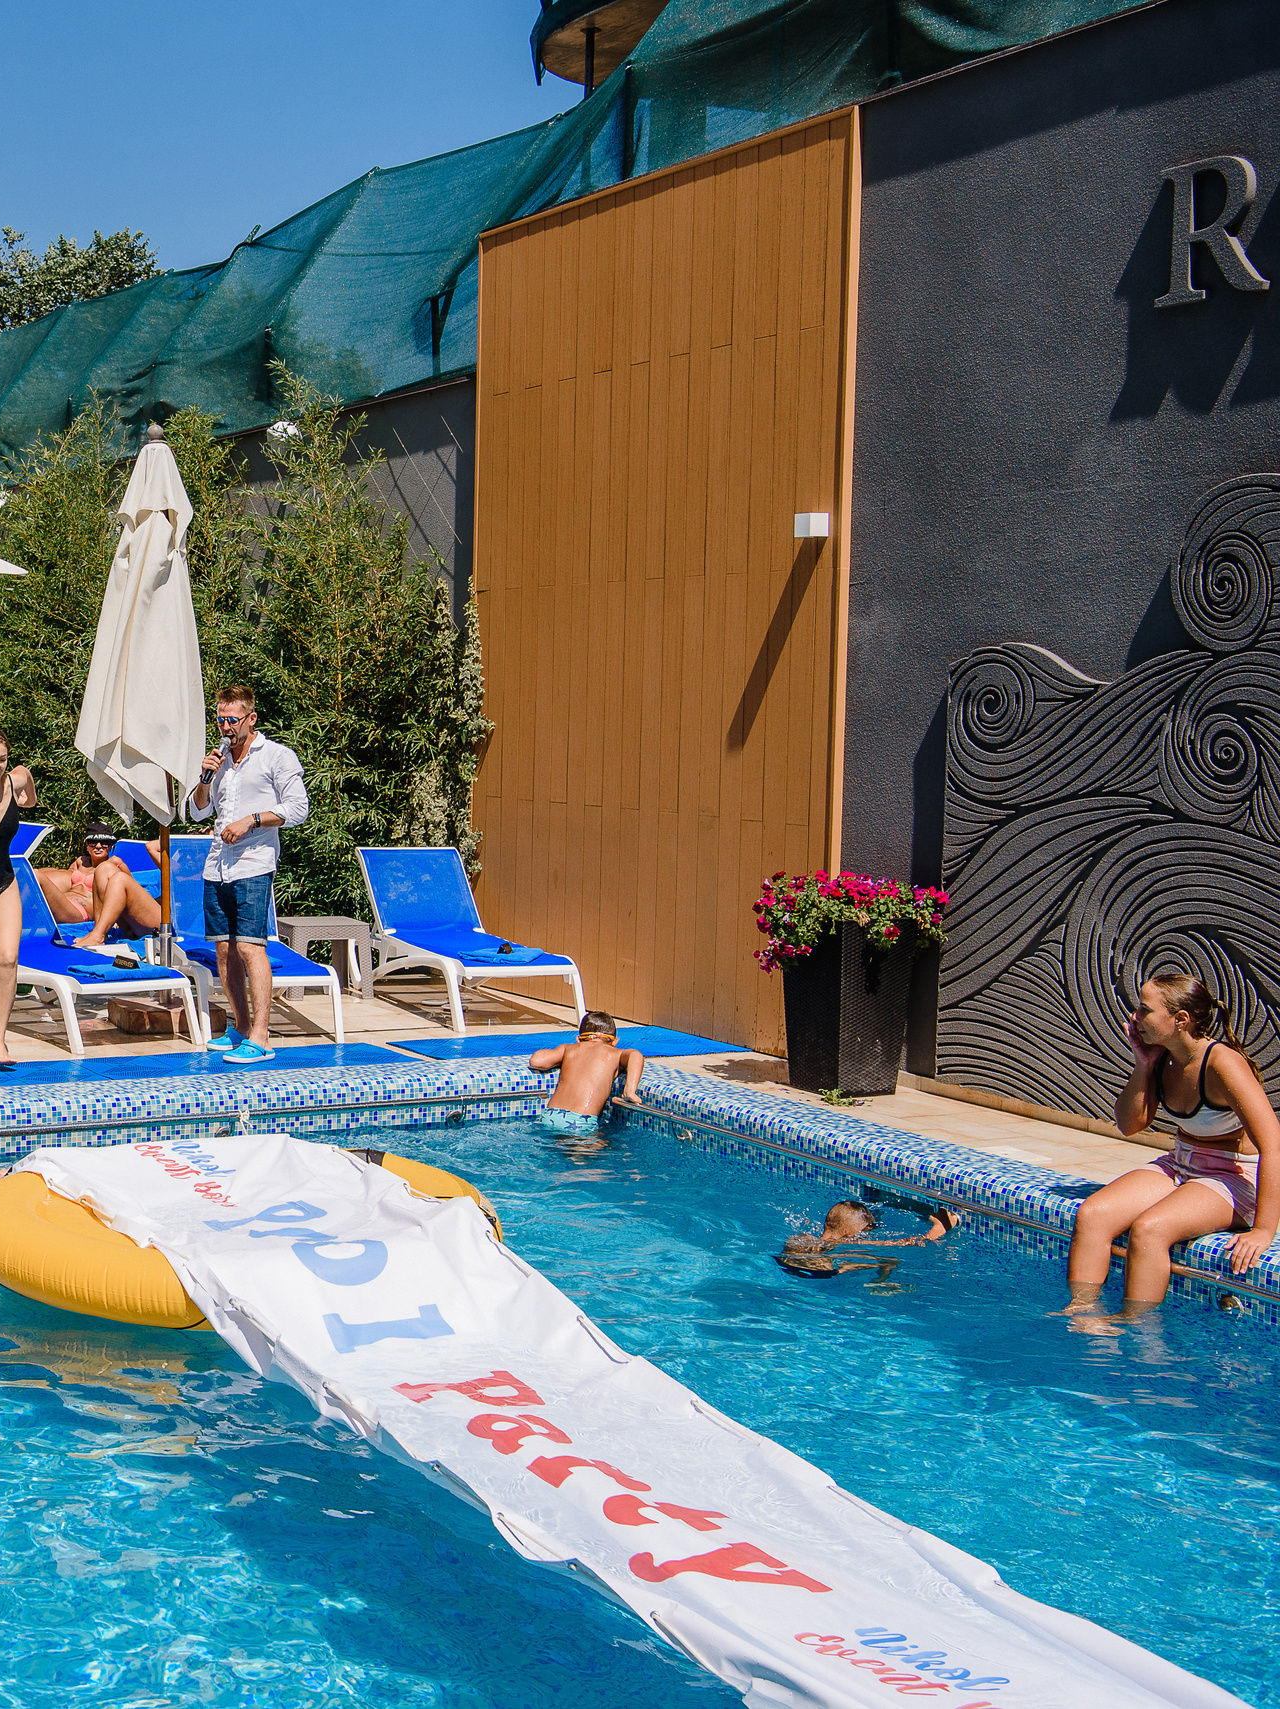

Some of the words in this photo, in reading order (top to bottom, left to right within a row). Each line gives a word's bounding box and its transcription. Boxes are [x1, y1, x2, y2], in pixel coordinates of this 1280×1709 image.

[1154, 155, 1270, 308] R
[390, 1370, 834, 1594] Party
[853, 1626, 1011, 1692] Nikol
